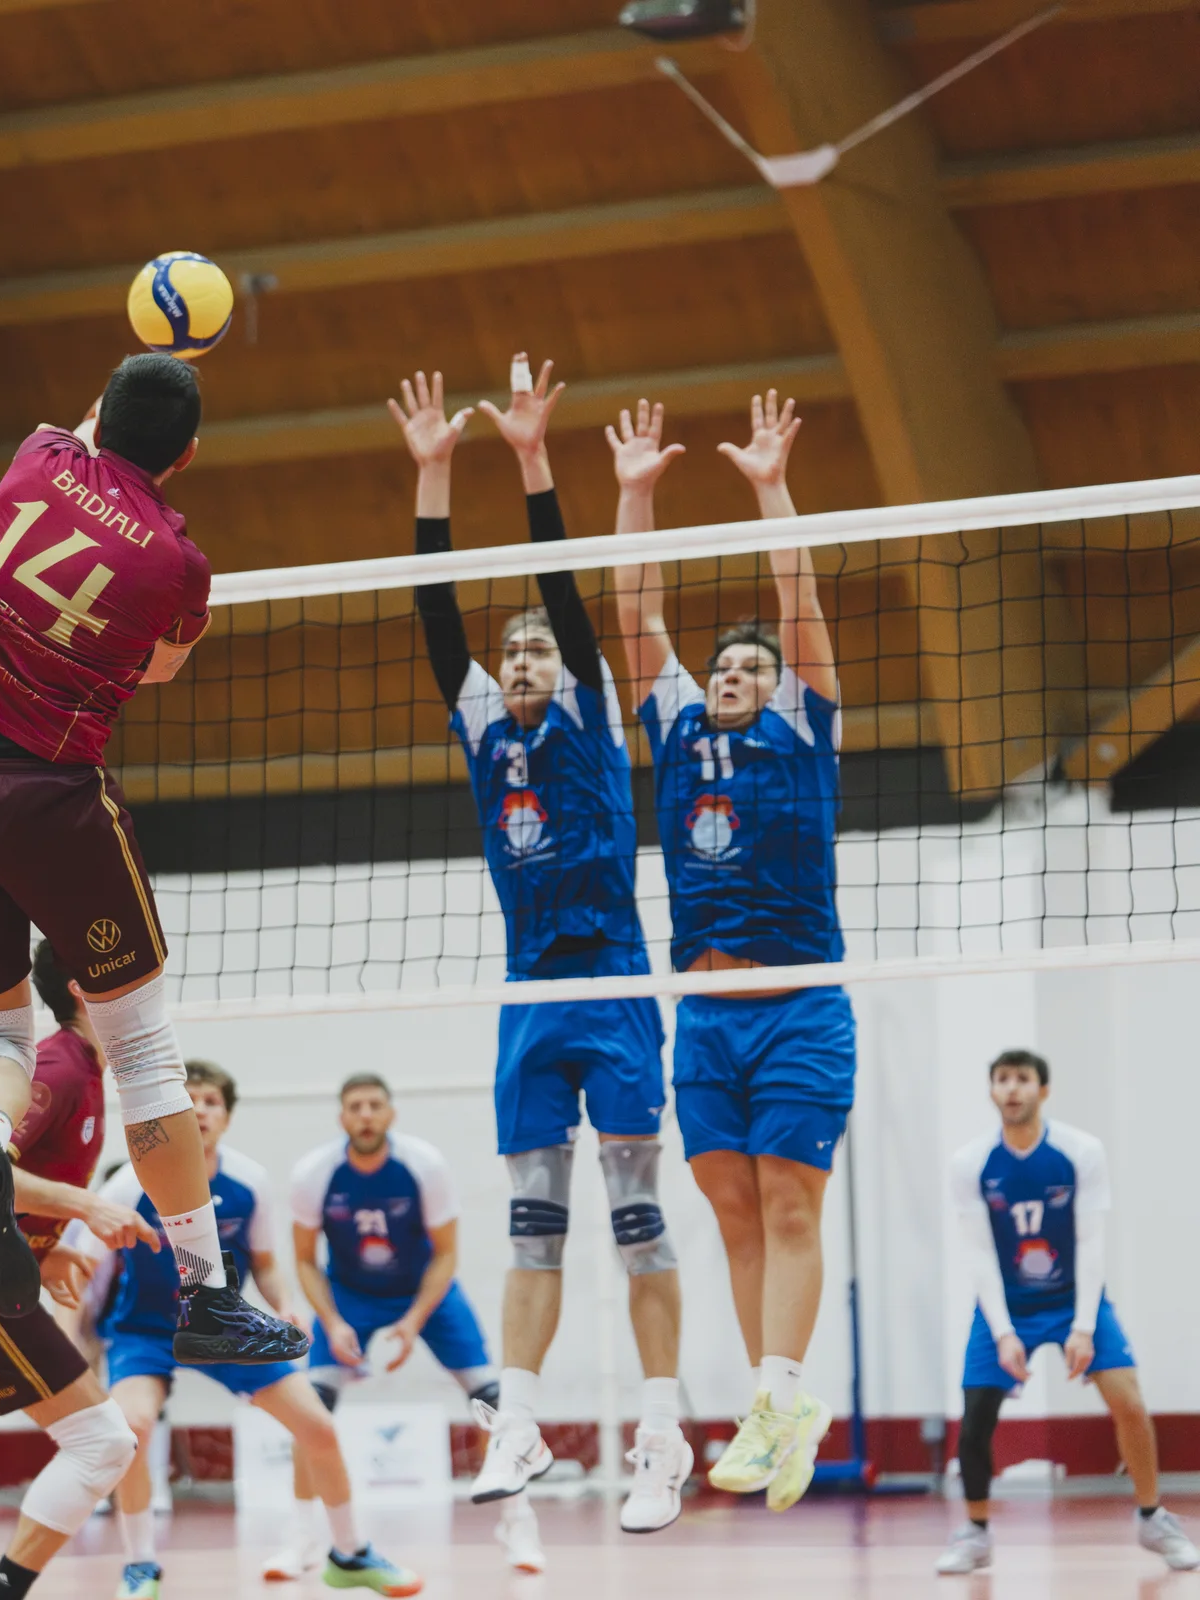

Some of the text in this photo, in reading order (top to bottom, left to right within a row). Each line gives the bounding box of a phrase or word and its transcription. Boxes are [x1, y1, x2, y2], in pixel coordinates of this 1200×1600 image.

[52, 469, 155, 549] BADIALI
[506, 741, 529, 788] 3
[693, 733, 734, 781] 11
[88, 950, 136, 978] Unicar
[1010, 1200, 1045, 1236] 17
